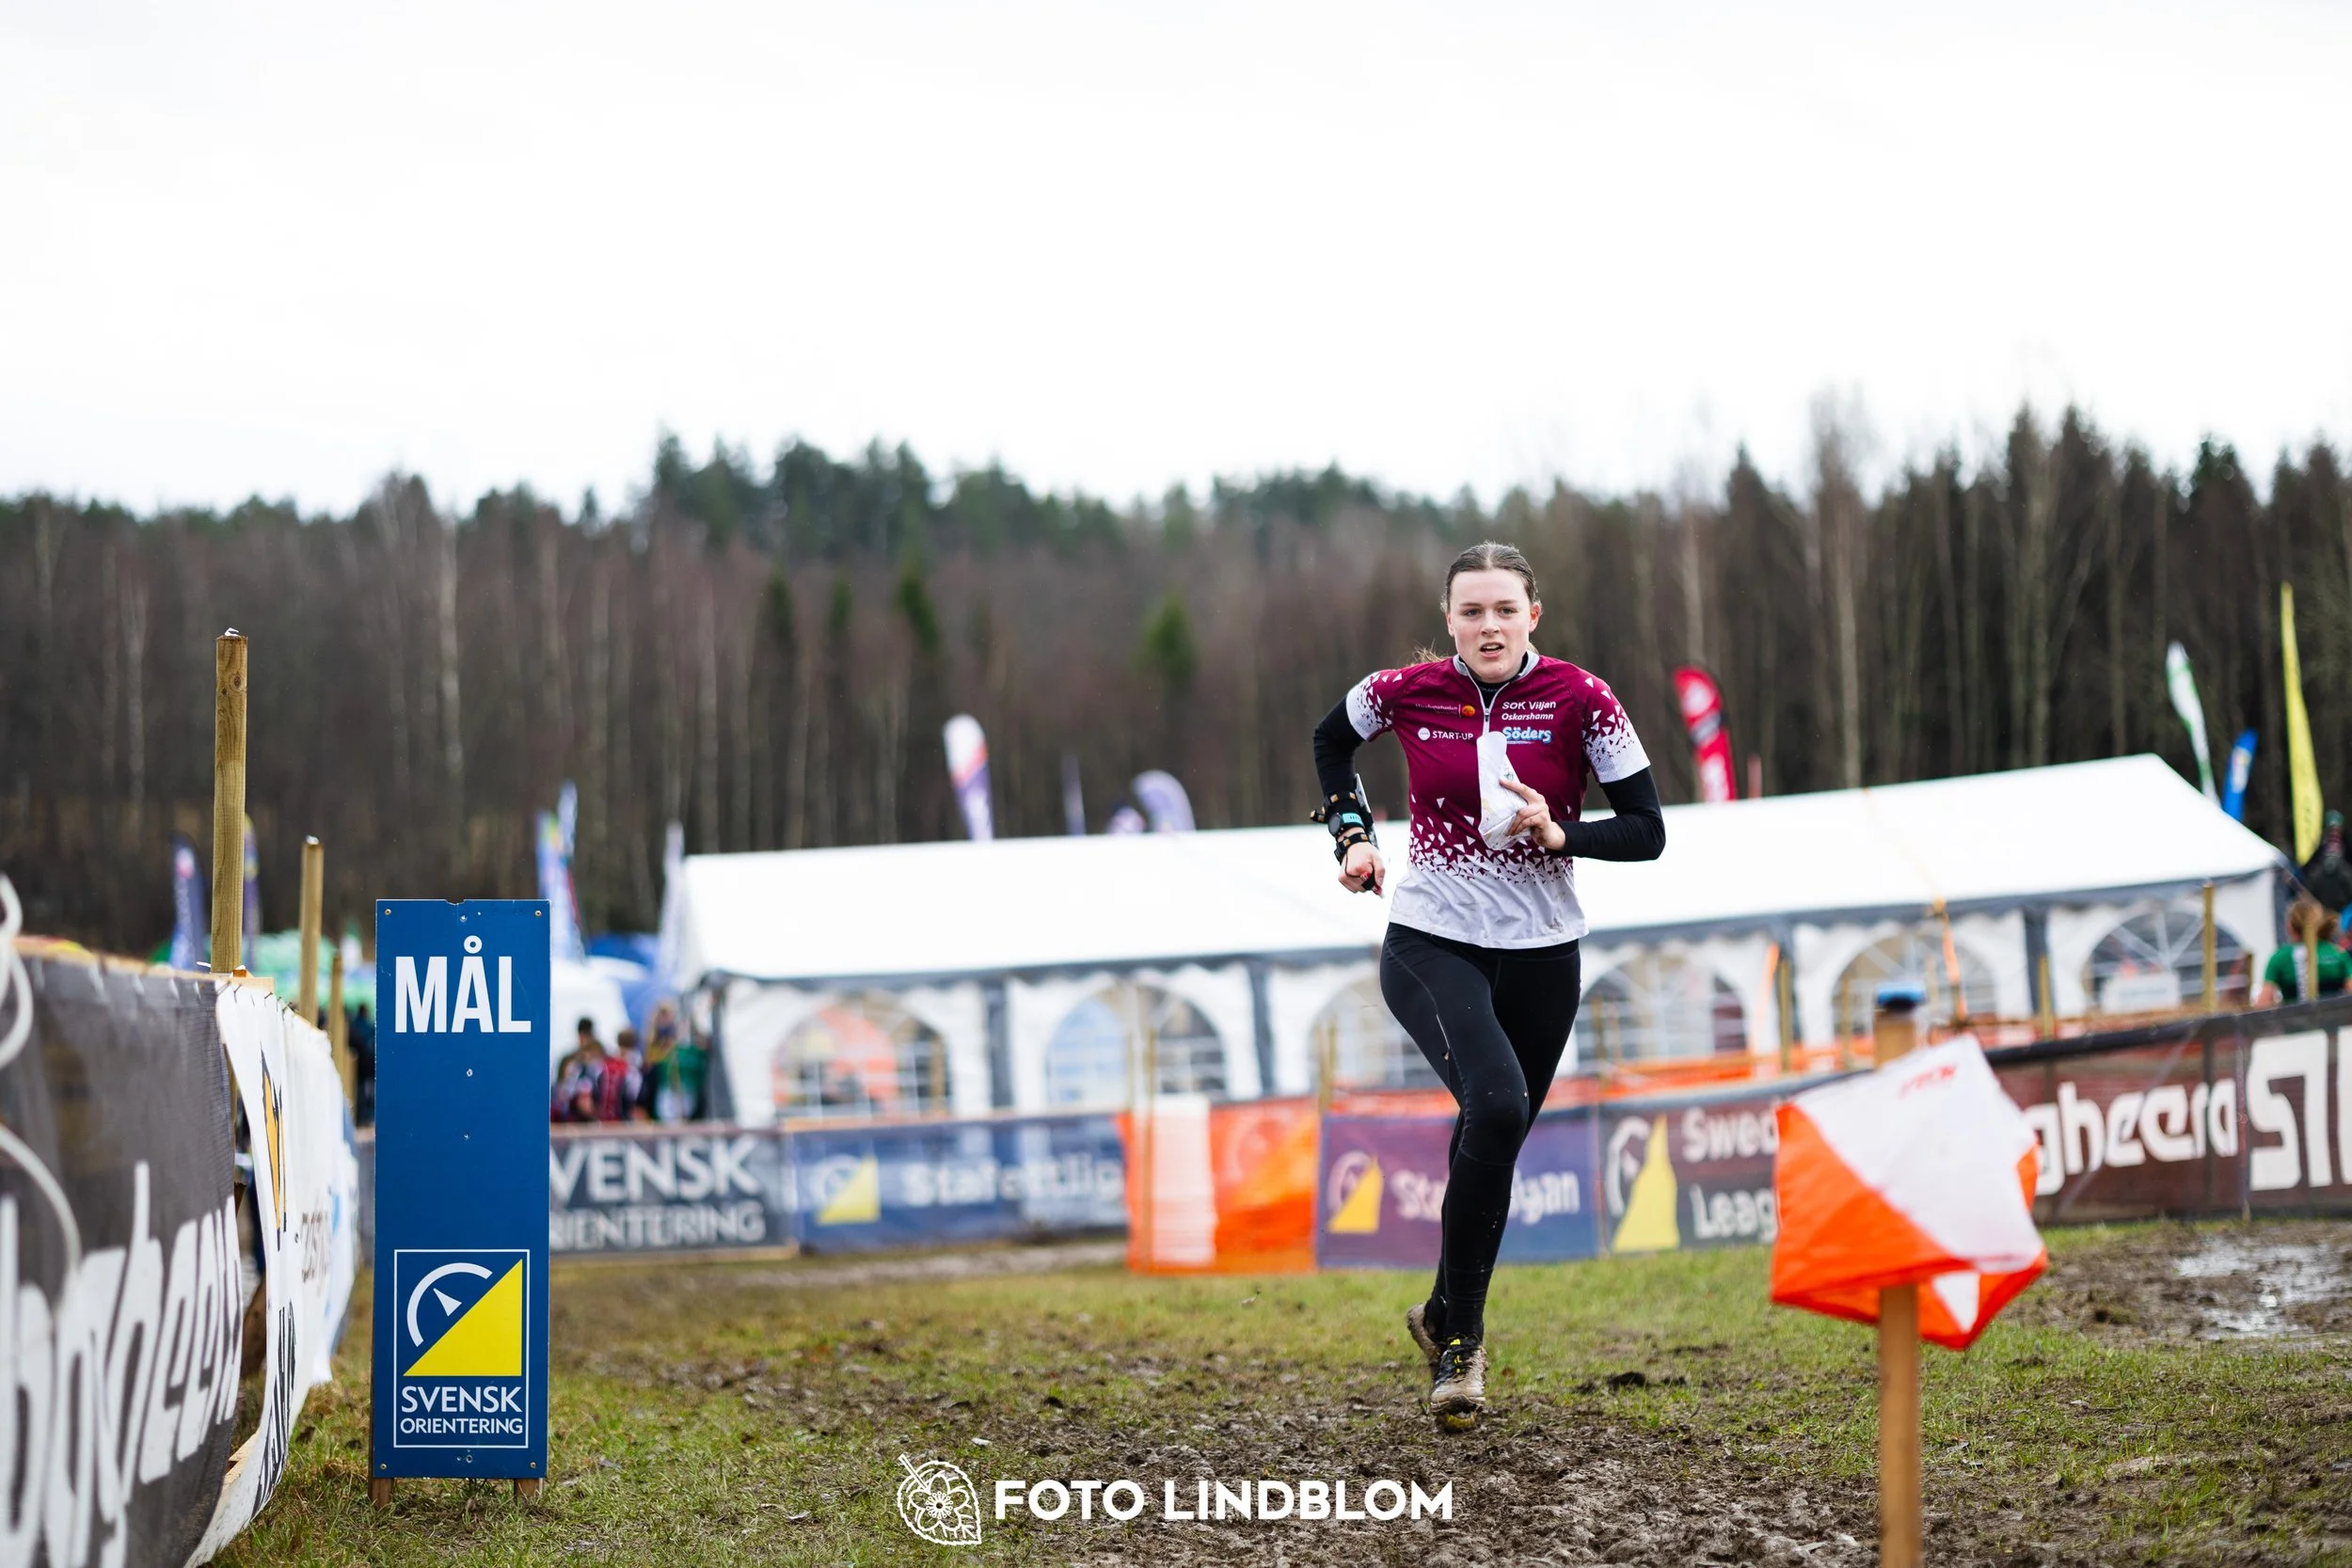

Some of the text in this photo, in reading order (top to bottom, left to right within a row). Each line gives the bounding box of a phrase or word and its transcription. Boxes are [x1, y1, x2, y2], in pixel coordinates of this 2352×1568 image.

[1502, 701, 1557, 711] SOK Viljan
[1502, 712, 1554, 721] Oskarshamn
[1432, 730, 1474, 740] START-UP
[1502, 726, 1552, 743] Söders
[395, 935, 532, 1033] MÅL
[402, 1386, 523, 1413] SVENSK
[400, 1418, 523, 1434] ORIENTERING
